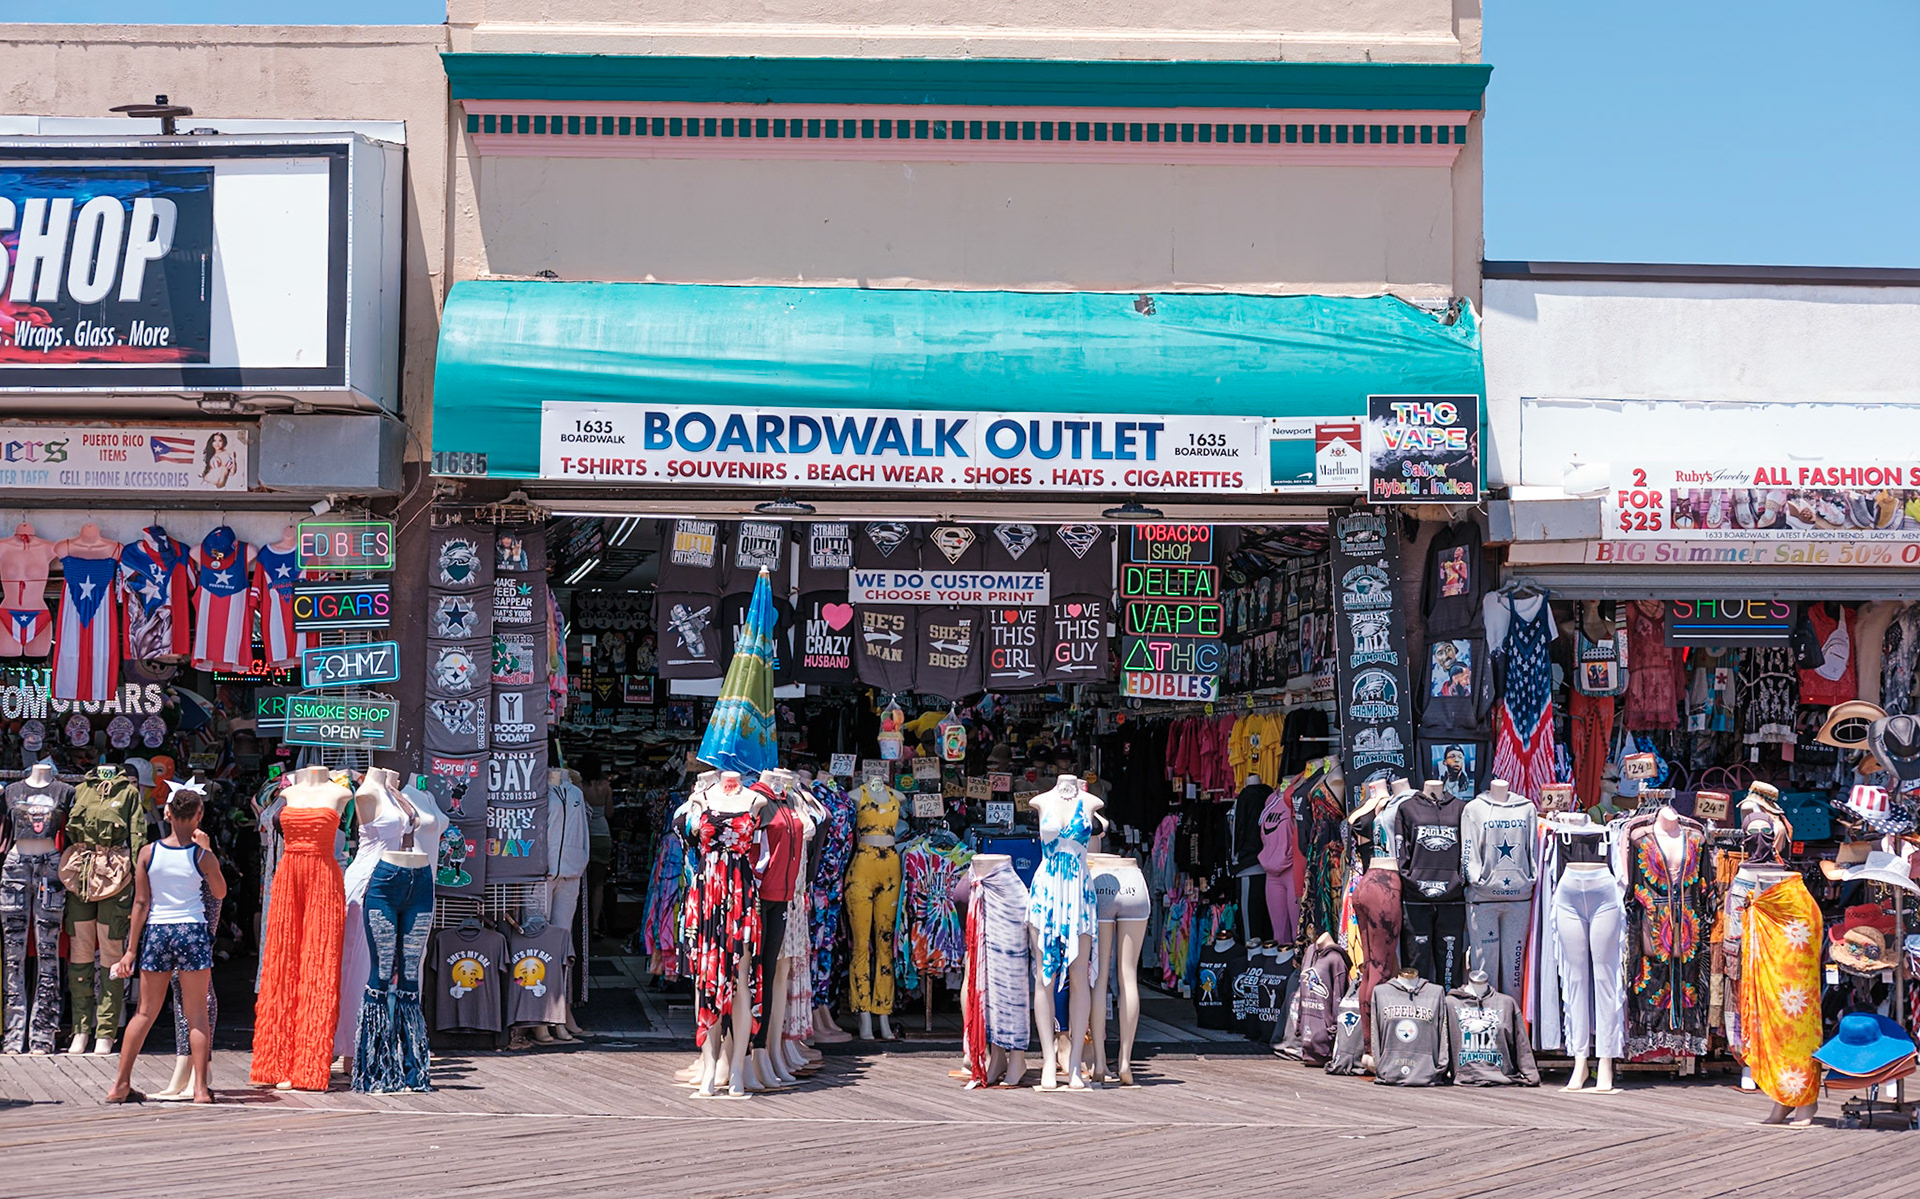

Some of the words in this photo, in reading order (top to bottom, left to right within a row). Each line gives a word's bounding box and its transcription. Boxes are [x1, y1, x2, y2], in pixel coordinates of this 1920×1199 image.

[15, 320, 63, 353] Wraps
[75, 320, 115, 347] Glass
[129, 321, 170, 347] More
[1390, 402, 1458, 425] THC
[575, 420, 613, 434] 1635
[1272, 428, 1312, 436] Newport
[560, 433, 625, 444] BOARDWALK
[644, 411, 970, 459] BOARDWALK
[985, 418, 1165, 461] OUTLET
[1188, 433, 1227, 447] 1635
[1381, 428, 1467, 450] VAPE
[0, 437, 69, 463] ers
[82, 434, 119, 446] PUERTO
[122, 434, 144, 446] RICO
[100, 450, 127, 462] ITEMS
[1174, 447, 1239, 458] BOARDWALK
[432, 453, 488, 474] 1635
[560, 456, 647, 476] T-SHIRTS
[667, 459, 788, 479] SOUVENIRS
[806, 463, 875, 482] BEACH
[882, 466, 944, 483] WEAR
[964, 467, 1031, 485] SHOES
[1052, 469, 1104, 486] HATS
[1124, 470, 1243, 488] CIGARETTES
[1320, 462, 1359, 476] Marlboro
[1402, 460, 1447, 477] Sativa
[20, 470, 49, 485] TAFFY
[60, 470, 80, 486] CELL
[84, 471, 120, 486] PHONE
[124, 471, 190, 488] ACCESSORIES
[1632, 468, 1647, 488] 2
[1676, 470, 1713, 486] Ruby's
[1711, 468, 1751, 484] Jewelry
[1753, 467, 1794, 486] ALL
[1799, 467, 1903, 486] FASHION
[1374, 479, 1420, 498] Hybrid
[1430, 479, 1473, 495] Indica
[1618, 490, 1663, 508] FOR
[678, 520, 715, 536] STRAIGHT
[742, 524, 780, 538] STRAIGHT
[812, 524, 849, 536] STRAIGHT
[1337, 516, 1387, 539] CHAMPIONS
[1619, 512, 1662, 533] $25
[1136, 525, 1210, 542] TOBACCO
[300, 532, 389, 558] EDIBLES
[676, 532, 712, 553] OUTTA
[740, 536, 777, 556] OUTTA
[813, 537, 849, 554] OUTTA
[672, 550, 712, 564] PITTSBURGH
[1152, 544, 1192, 560] SHOP
[1596, 542, 1646, 562] BIG
[1654, 542, 1767, 562] Summer
[1774, 543, 1829, 563] Sale
[1840, 544, 1892, 564] 50%
[812, 555, 826, 566] NEW
[826, 555, 850, 568] ENGLAND
[855, 574, 886, 588] WE
[894, 574, 924, 588] DO
[930, 574, 1044, 590] CUSTOMIZE
[1127, 568, 1212, 596] DELTA
[865, 590, 930, 600] CHOOSE
[937, 590, 982, 602] YOUR
[988, 592, 1034, 602] PRINT
[1342, 590, 1392, 604] CHAMPIONS
[294, 594, 390, 618] CIGARS
[814, 602, 818, 620] I
[1054, 604, 1060, 618] I
[1673, 600, 1790, 619] SHOES
[863, 611, 904, 630] HE'S
[990, 610, 996, 623] I
[1132, 604, 1218, 634] VAPE
[1352, 612, 1390, 624] EAGLES
[806, 620, 829, 636] MY
[930, 624, 970, 640] SHE'S
[991, 626, 1036, 646] THIS
[1055, 620, 1100, 640] THIS
[806, 636, 851, 655] CRAZY
[866, 643, 903, 662] MAN
[1055, 642, 1098, 663] GUY
[804, 655, 850, 669] HUSBAND
[929, 652, 968, 668] BOSS
[991, 649, 1036, 668] GIRL
[1350, 652, 1398, 669] CHAMPIONS
[1127, 672, 1212, 698] EDIBLES
[0, 685, 47, 719] OM
[294, 704, 345, 720] SMOKE
[348, 706, 390, 722] SHOP
[1350, 704, 1399, 718] CHAMPIONS
[320, 725, 360, 739] OPEN
[477, 698, 485, 749] YANKEES
[494, 724, 536, 732] POOPED
[495, 733, 530, 742] TODAY!
[508, 752, 534, 760] NOT
[1354, 754, 1404, 770] CHAMPIONS
[488, 759, 536, 792] GAY
[501, 792, 514, 800] $20
[516, 792, 522, 800] IS
[524, 792, 537, 800] $20
[487, 807, 536, 819] SORRY
[498, 828, 522, 840] I'M
[1416, 826, 1458, 839] EAGLES
[486, 839, 535, 857] GAY
[1118, 886, 1136, 896] City
[1419, 881, 1448, 890] EAGLES
[446, 951, 466, 966] SHE'S
[467, 951, 478, 959] MY
[478, 956, 490, 968] BAE
[526, 949, 538, 958] MY
[538, 951, 552, 964] BAE
[1514, 946, 1522, 988] COWBOYS
[1384, 1004, 1434, 1023] STEELERS
[1458, 1052, 1503, 1068] CHAMPIONS
